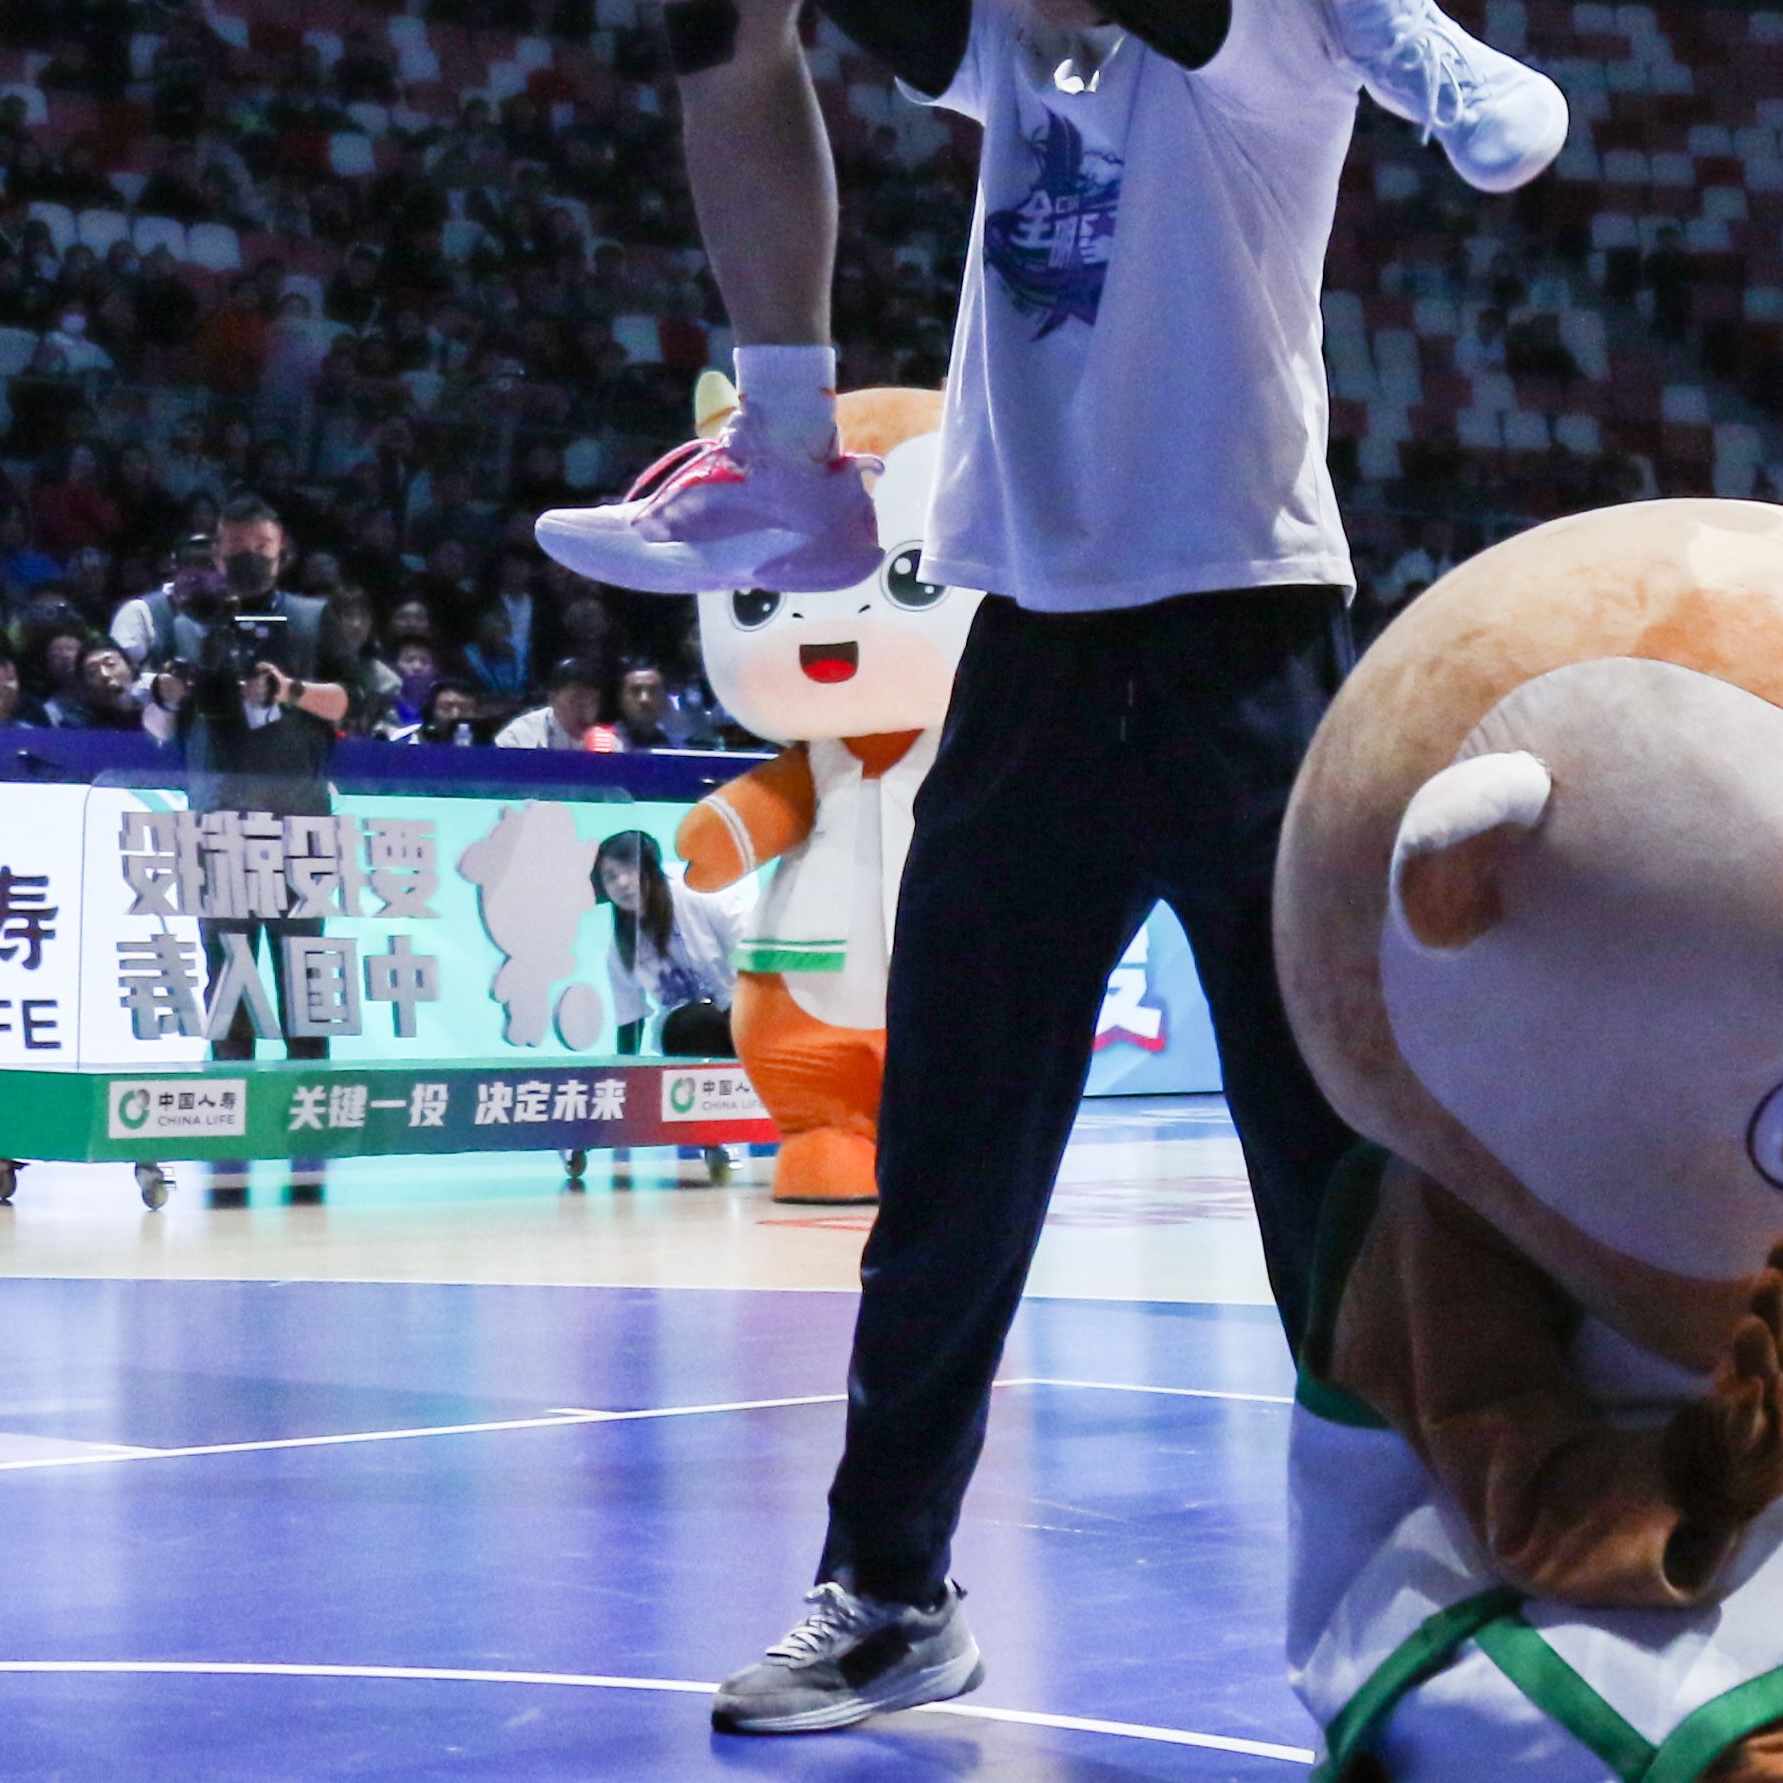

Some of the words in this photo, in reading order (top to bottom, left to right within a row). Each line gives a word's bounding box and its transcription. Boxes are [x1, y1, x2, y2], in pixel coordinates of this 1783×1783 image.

[701, 1076, 754, 1097] 中国人
[157, 1088, 237, 1113] 中国人寿
[287, 1083, 449, 1132] 关键一投
[474, 1079, 628, 1126] 决定未来
[701, 1099, 740, 1112] CHINA
[157, 1114, 200, 1129] CHINA
[205, 1111, 236, 1127] LIFE
